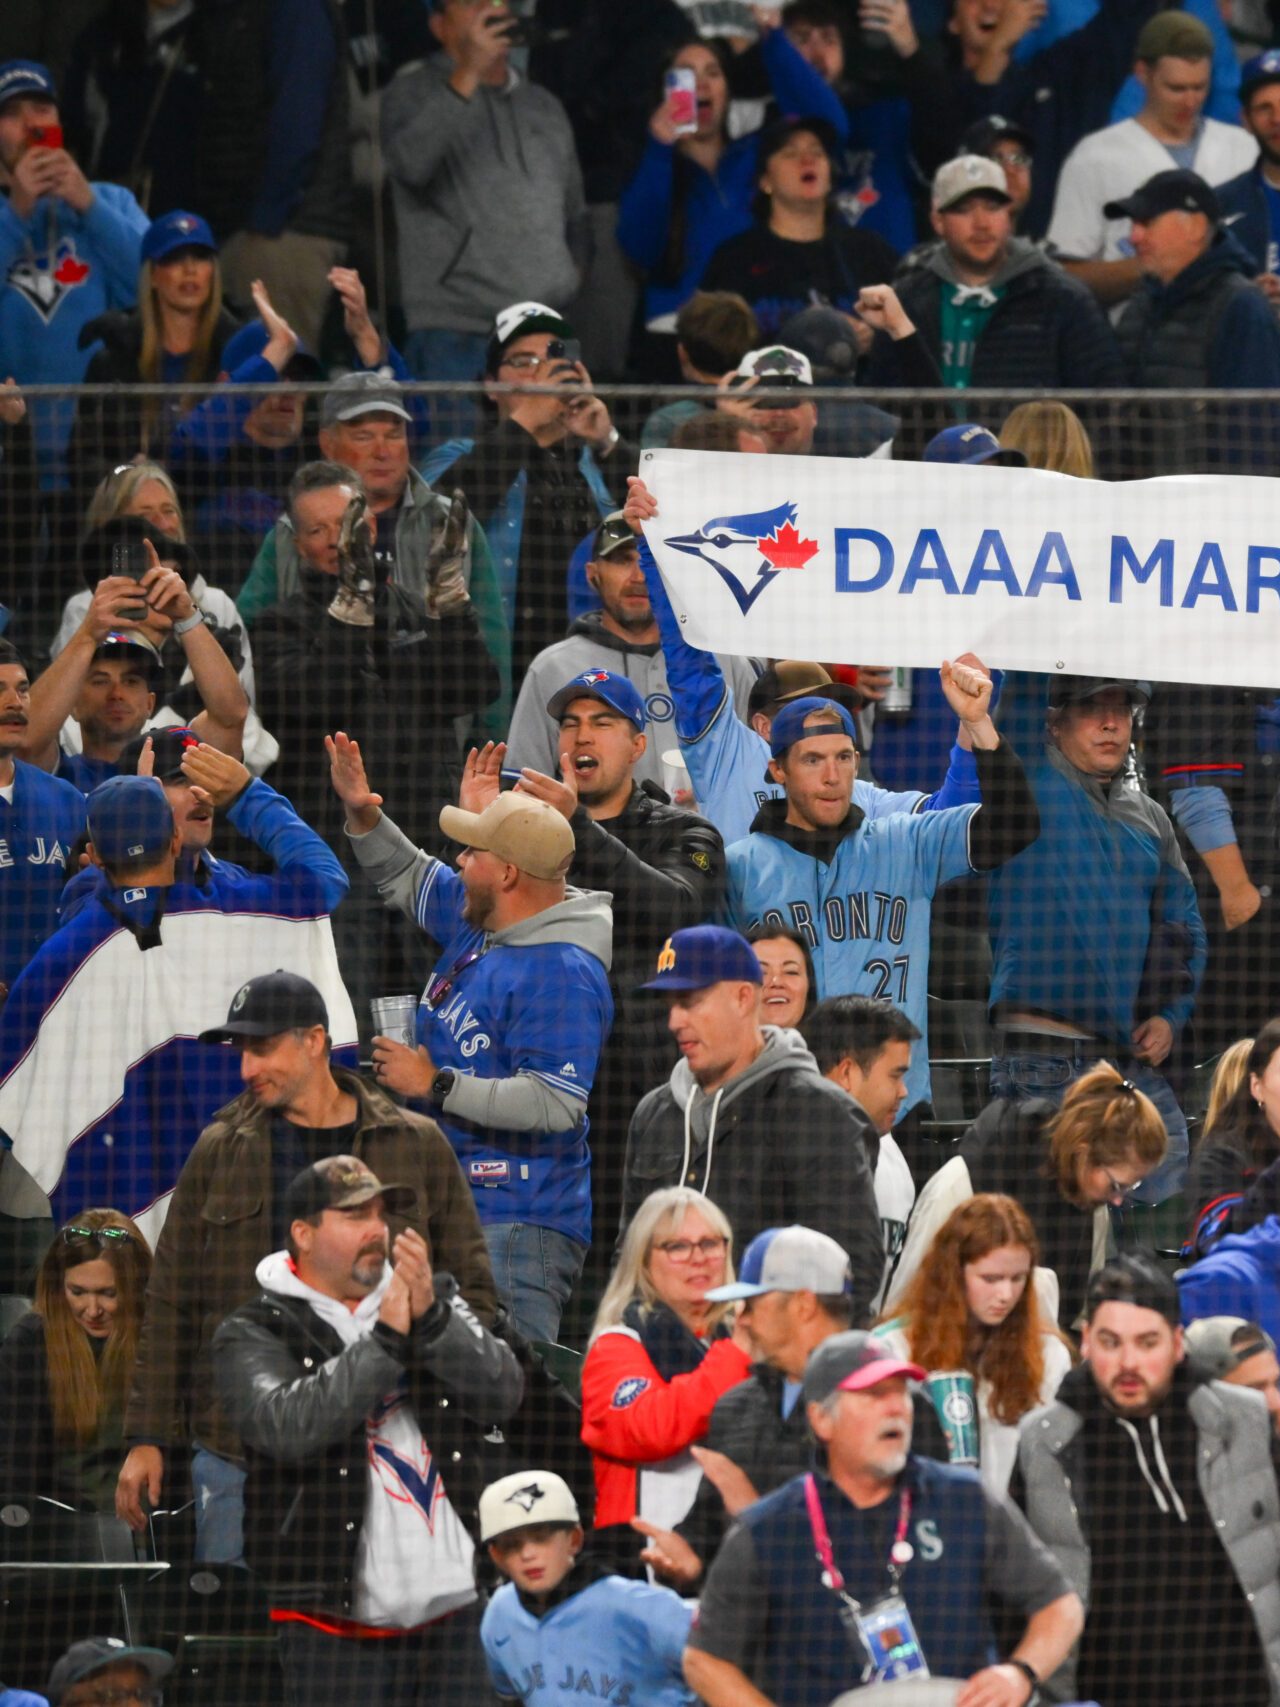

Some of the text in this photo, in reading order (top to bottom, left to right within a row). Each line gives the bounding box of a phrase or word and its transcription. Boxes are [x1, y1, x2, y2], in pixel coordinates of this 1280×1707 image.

[834, 528, 1082, 601] DAAA
[864, 955, 910, 1003] 27
[437, 991, 491, 1058] JAYS
[914, 1518, 944, 1561] S
